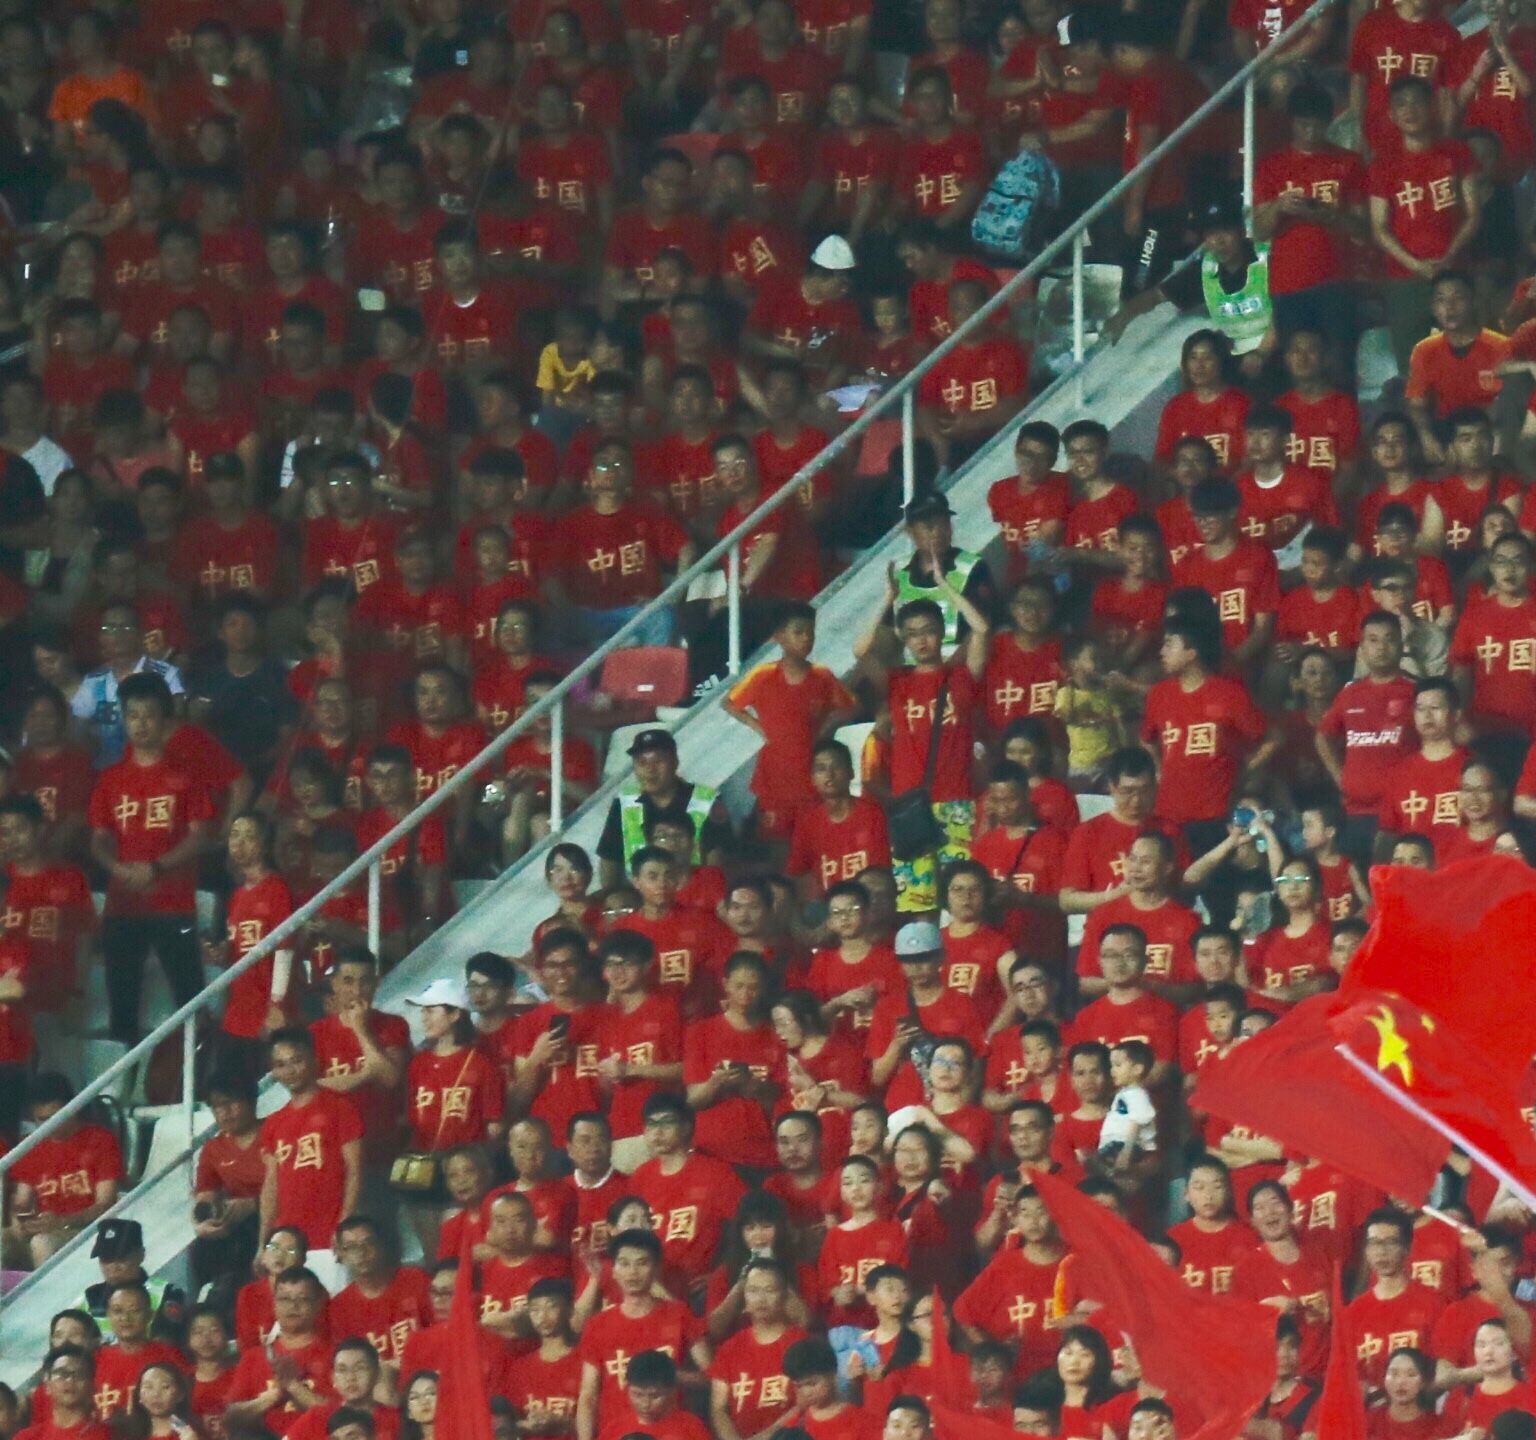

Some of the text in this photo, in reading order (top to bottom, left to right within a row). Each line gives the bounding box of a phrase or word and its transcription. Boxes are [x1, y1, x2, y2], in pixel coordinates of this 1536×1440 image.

[1377, 47, 1437, 84] 中国
[916, 174, 960, 205] 中国
[1396, 178, 1454, 219] 中国
[1140, 229, 1158, 267] FIGHT
[944, 379, 996, 411] 中国
[1287, 432, 1335, 468] 中国
[589, 540, 645, 576] 中国
[995, 679, 1059, 715] 中国
[1161, 721, 1216, 758] 中国
[114, 794, 174, 831] 中国
[1401, 791, 1461, 826] 中国
[417, 1086, 468, 1120] 中国
[275, 1132, 322, 1169] 中国
[732, 1372, 789, 1408] 中国
